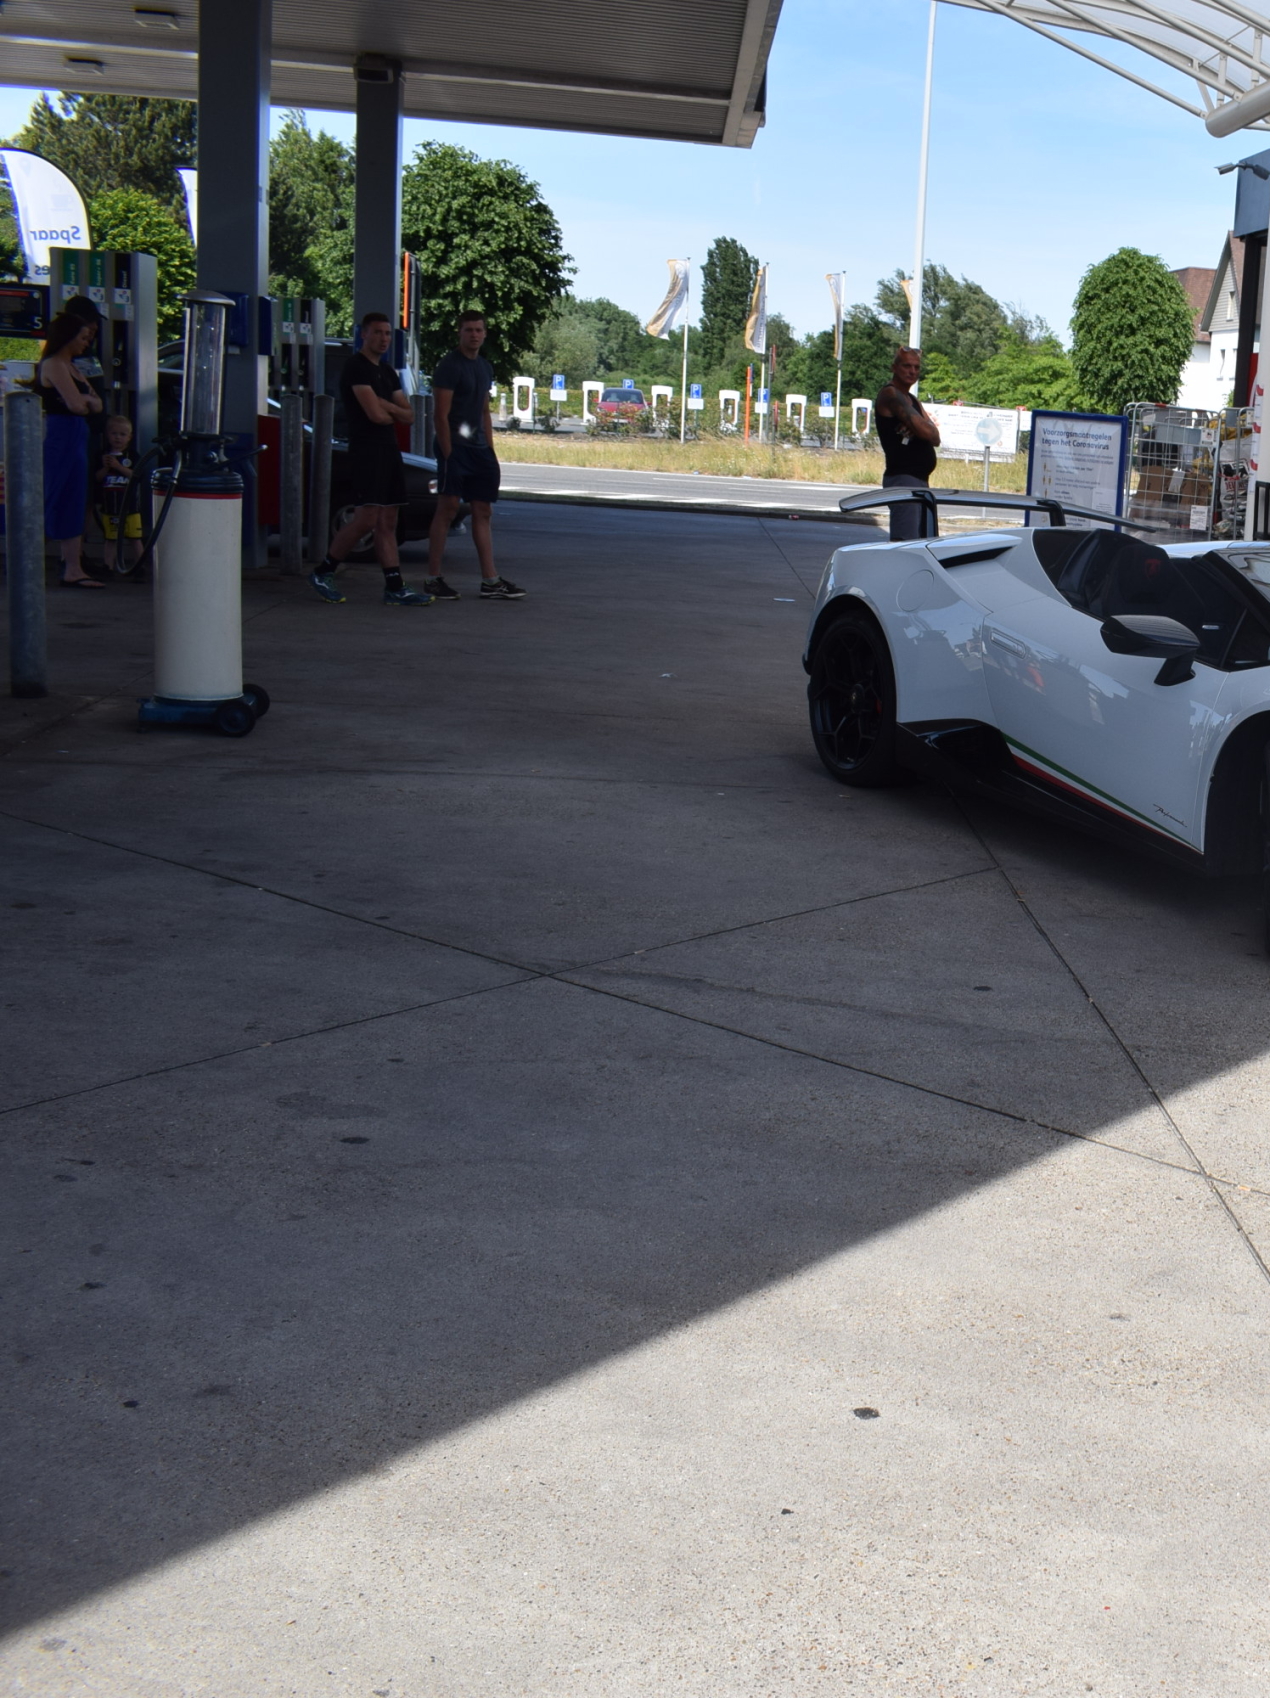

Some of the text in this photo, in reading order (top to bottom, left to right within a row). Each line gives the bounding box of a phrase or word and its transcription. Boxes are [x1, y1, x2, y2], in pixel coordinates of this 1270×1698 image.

[33, 316, 43, 330] 5
[1042, 428, 1112, 442] Voorzorgsmaatregelen
[1041, 438, 1110, 451] tegen het Coronavirus
